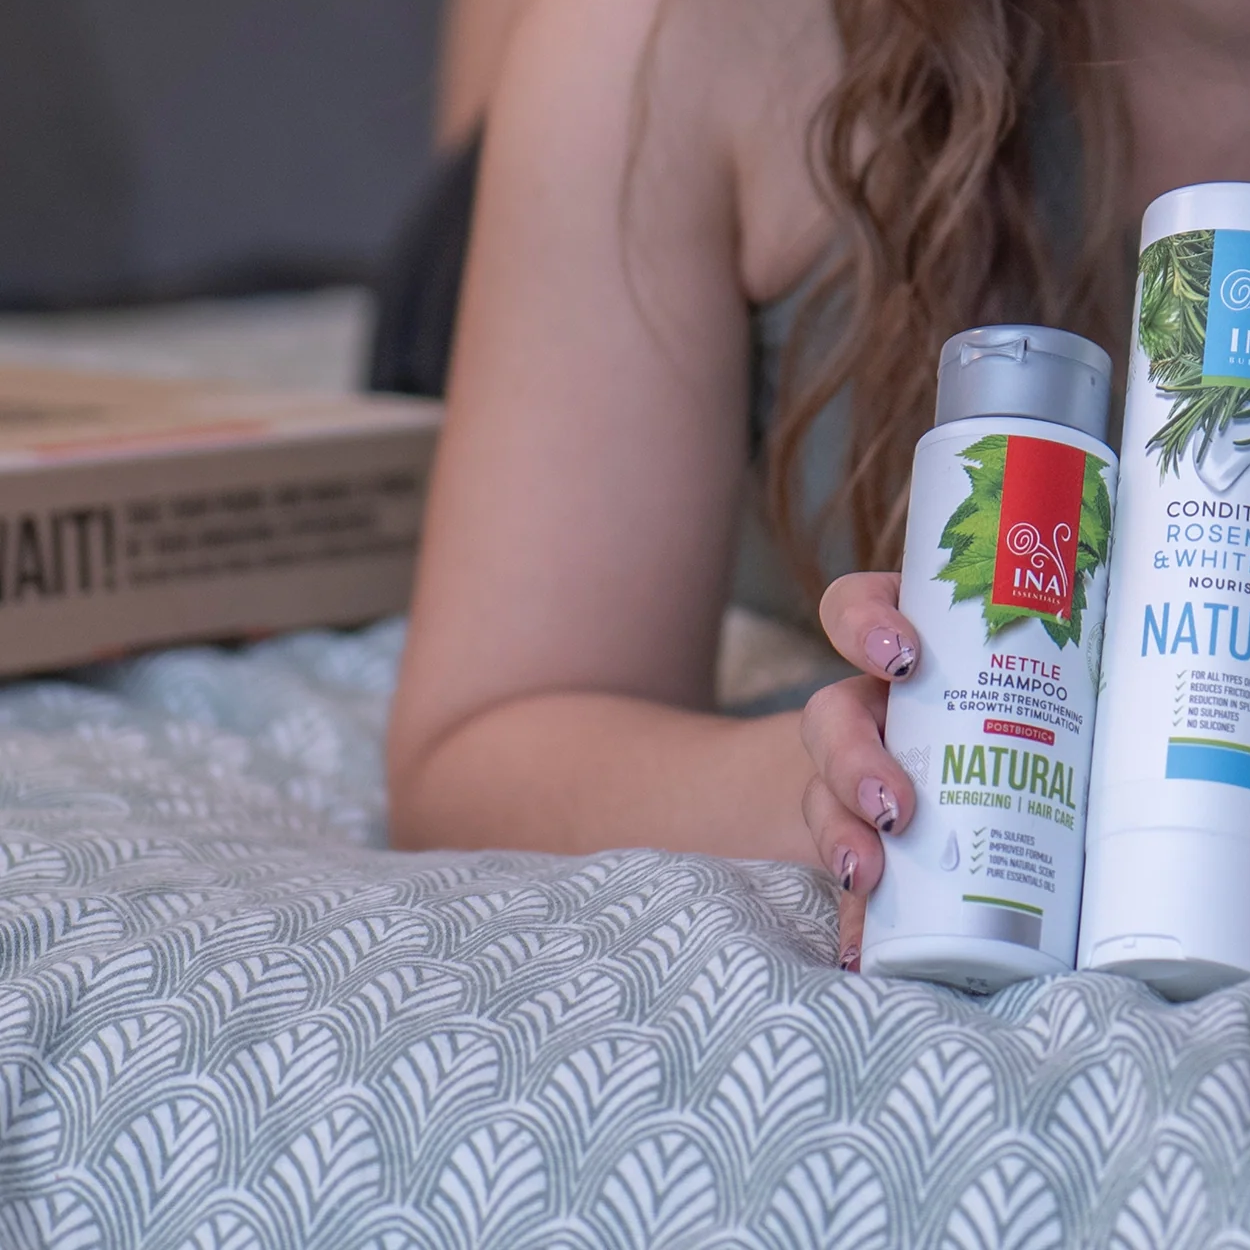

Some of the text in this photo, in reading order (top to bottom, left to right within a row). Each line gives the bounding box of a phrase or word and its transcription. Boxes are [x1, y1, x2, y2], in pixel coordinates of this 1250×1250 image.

[0, 500, 117, 604] AIT!
[1013, 567, 1061, 597] INA
[1012, 589, 1061, 605] ESSENTIALS
[990, 653, 1061, 681] NETTLE
[1191, 670, 1204, 681] FOR
[1207, 671, 1220, 682] ALL
[1222, 673, 1243, 686] TYPES
[977, 671, 1068, 701] SHAMPOO
[1190, 682, 1222, 695] REDUCES
[943, 690, 1083, 725] FOR HAIR STRENGTHENING
[1188, 694, 1229, 707] REDUCTION
[1230, 698, 1238, 708] IN
[946, 701, 1080, 735] & GROWTH STIMULATION
[1186, 719, 1236, 734] NO SILICONES
[1187, 707, 1240, 722] NO SULPHATES
[986, 722, 1053, 741] POSTBIOTIC+
[941, 744, 1076, 810] NATURAL
[939, 790, 1076, 831] ENERGIZING HAIR CARE
[990, 828, 1035, 846] 0% SULFATES
[989, 842, 1053, 865] IMPROVED FORMULA
[986, 867, 1006, 880] PURE
[1043, 880, 1056, 893] OILS
[989, 855, 1056, 880] 100% NATURAL SCENT
